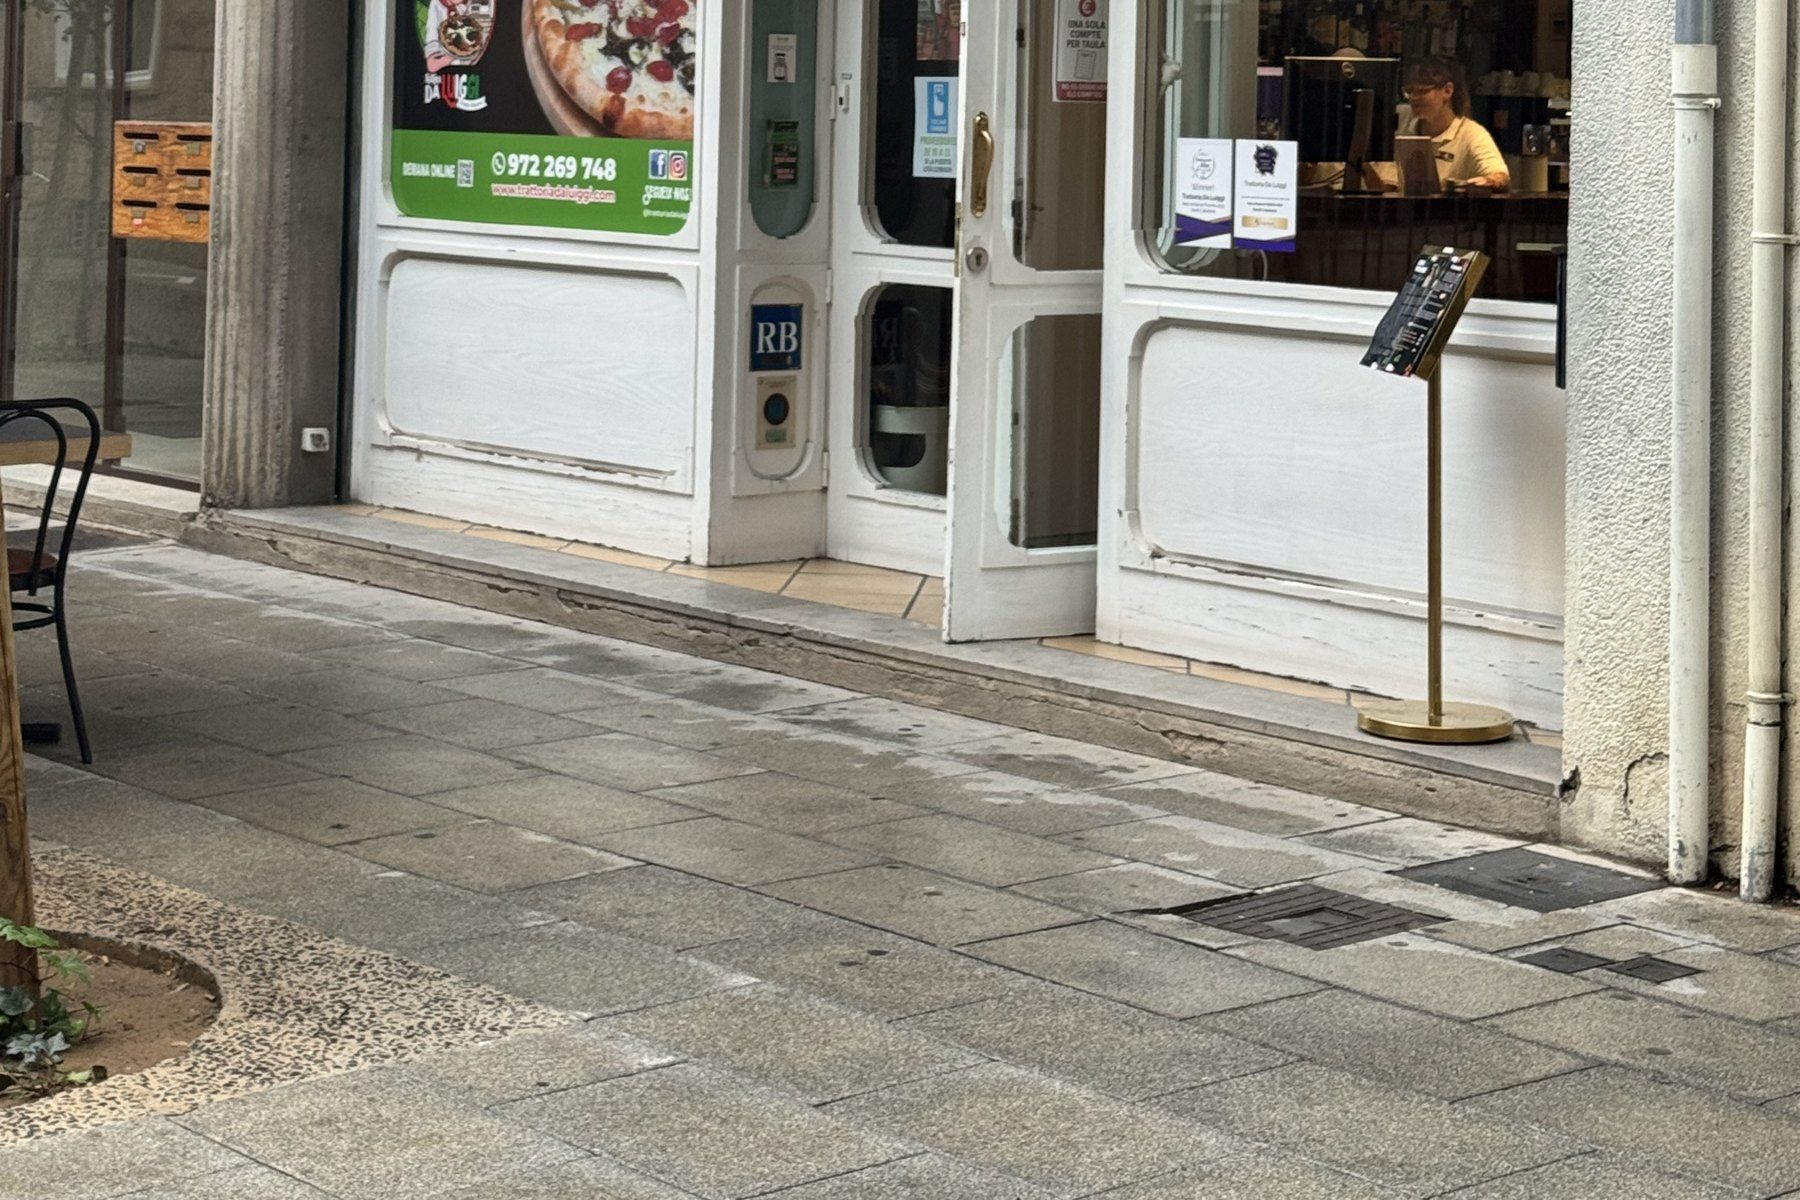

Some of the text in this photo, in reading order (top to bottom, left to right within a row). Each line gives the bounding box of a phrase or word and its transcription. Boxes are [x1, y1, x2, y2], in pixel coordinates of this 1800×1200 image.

[1068, 20, 1106, 29] UNA SOLA
[1070, 30, 1102, 39] COMPTE
[1066, 40, 1106, 49] PER TAULA
[424, 84, 440, 104] DA
[430, 163, 456, 178] ONLINE
[508, 153, 616, 181] 972 269 748
[756, 321, 798, 354] RB
